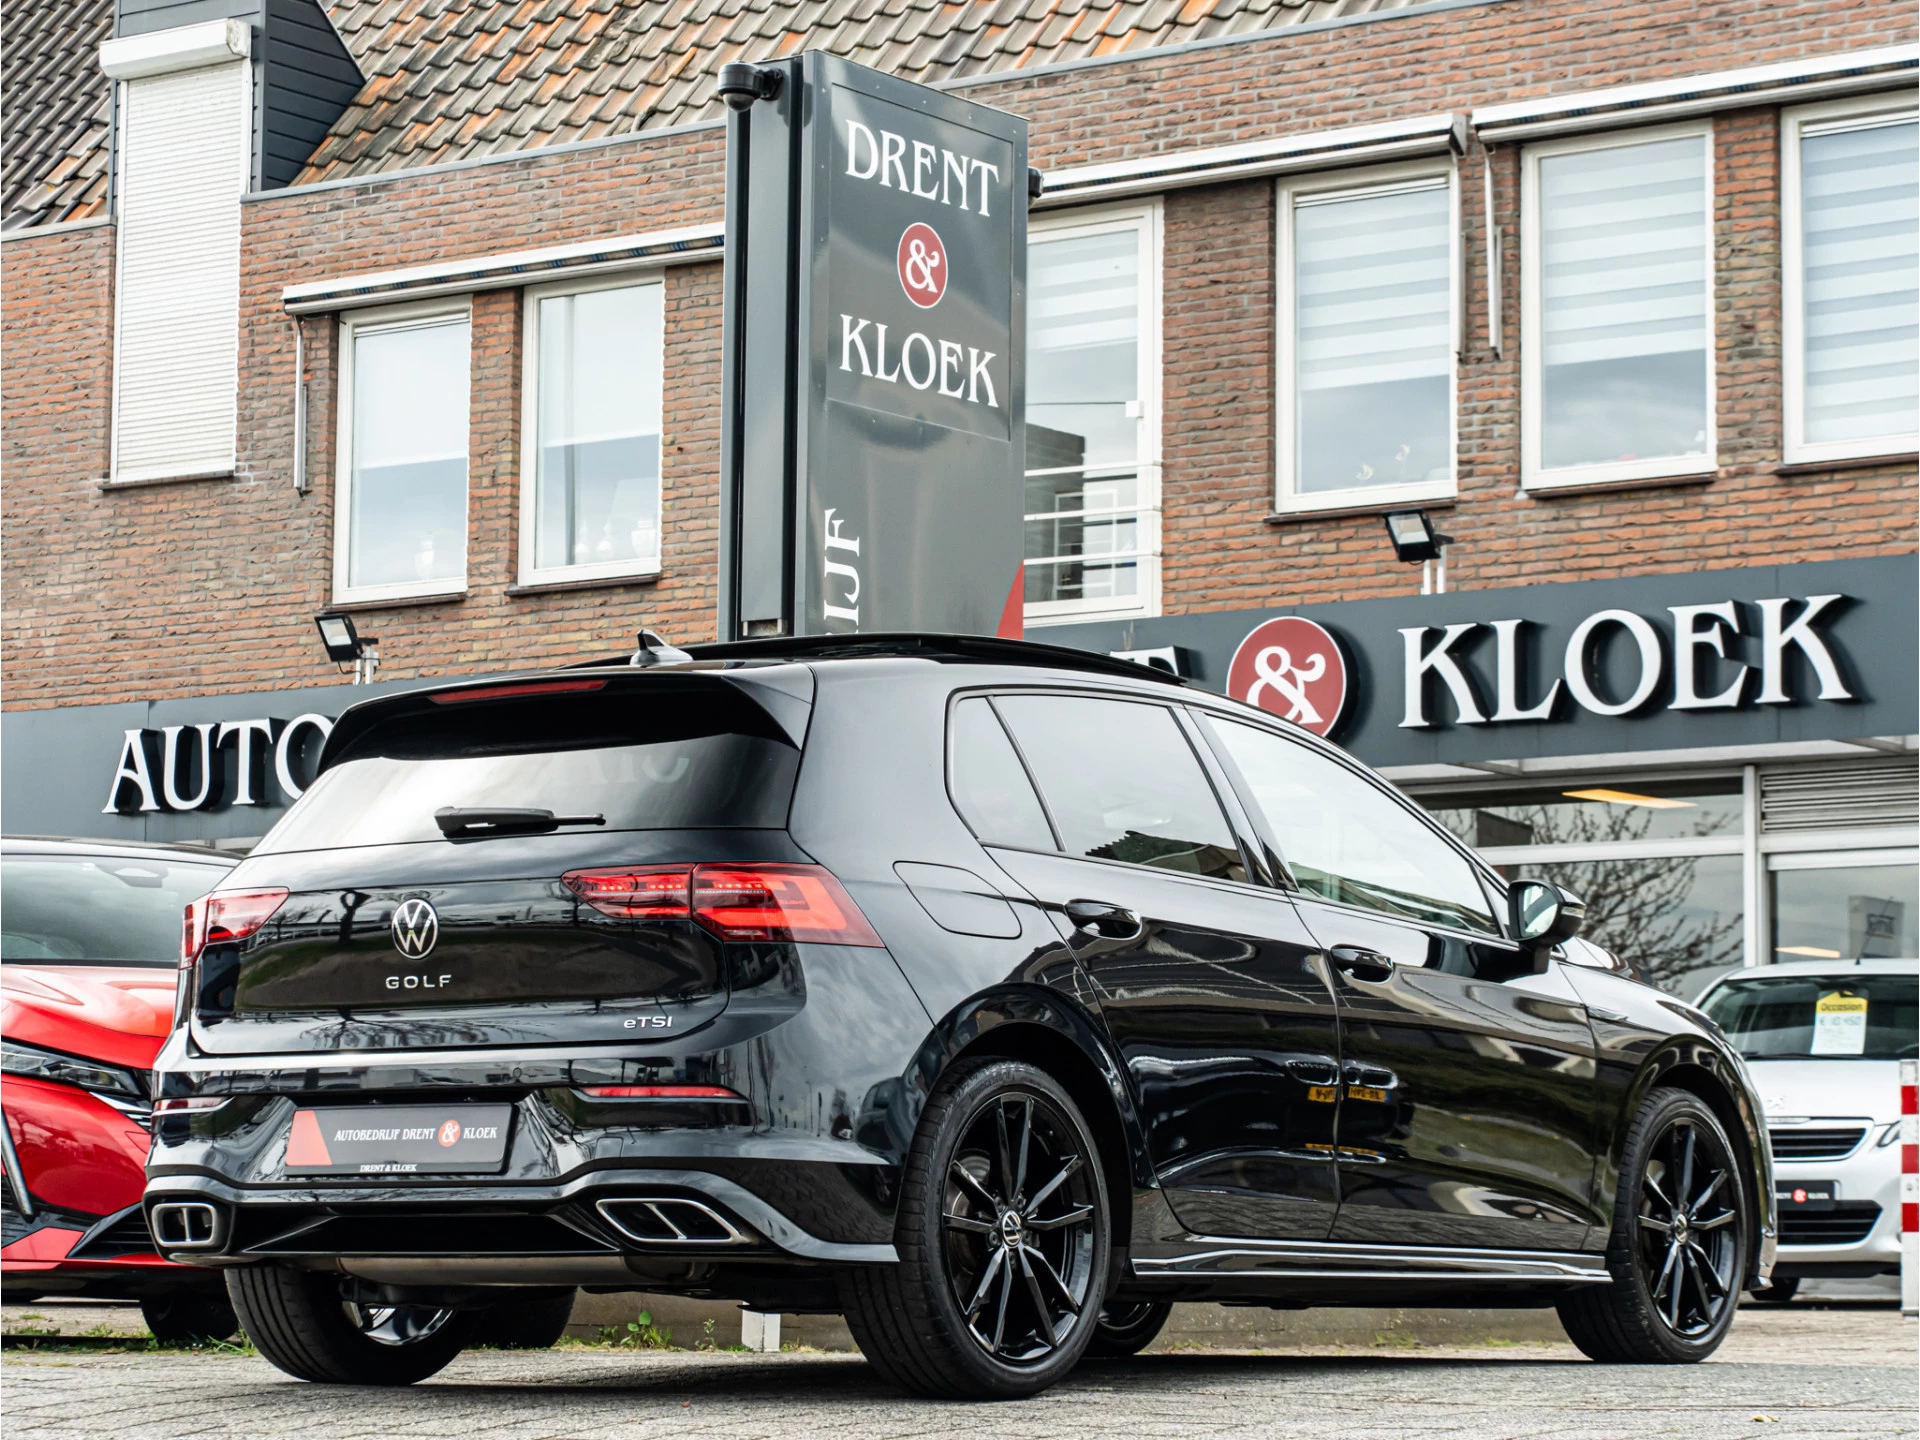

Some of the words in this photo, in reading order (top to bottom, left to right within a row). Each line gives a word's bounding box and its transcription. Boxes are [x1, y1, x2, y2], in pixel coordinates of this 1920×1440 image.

[845, 118, 999, 217] DRENT
[905, 238, 940, 293] &
[839, 313, 999, 408] KLOEK
[1246, 644, 1327, 724] &
[1397, 593, 1856, 729] KLOEK
[385, 974, 453, 990] GOLF
[1820, 1002, 1864, 1012] Occasion
[623, 1016, 674, 1029] eTSI
[334, 1129, 400, 1141] AUTOBEDRIJF
[402, 1128, 436, 1140] DRENT
[441, 1122, 459, 1144] &
[463, 1127, 499, 1139] KLOEK
[359, 1164, 383, 1173] DRENT
[384, 1164, 391, 1173] &
[391, 1164, 418, 1173] KLOEK
